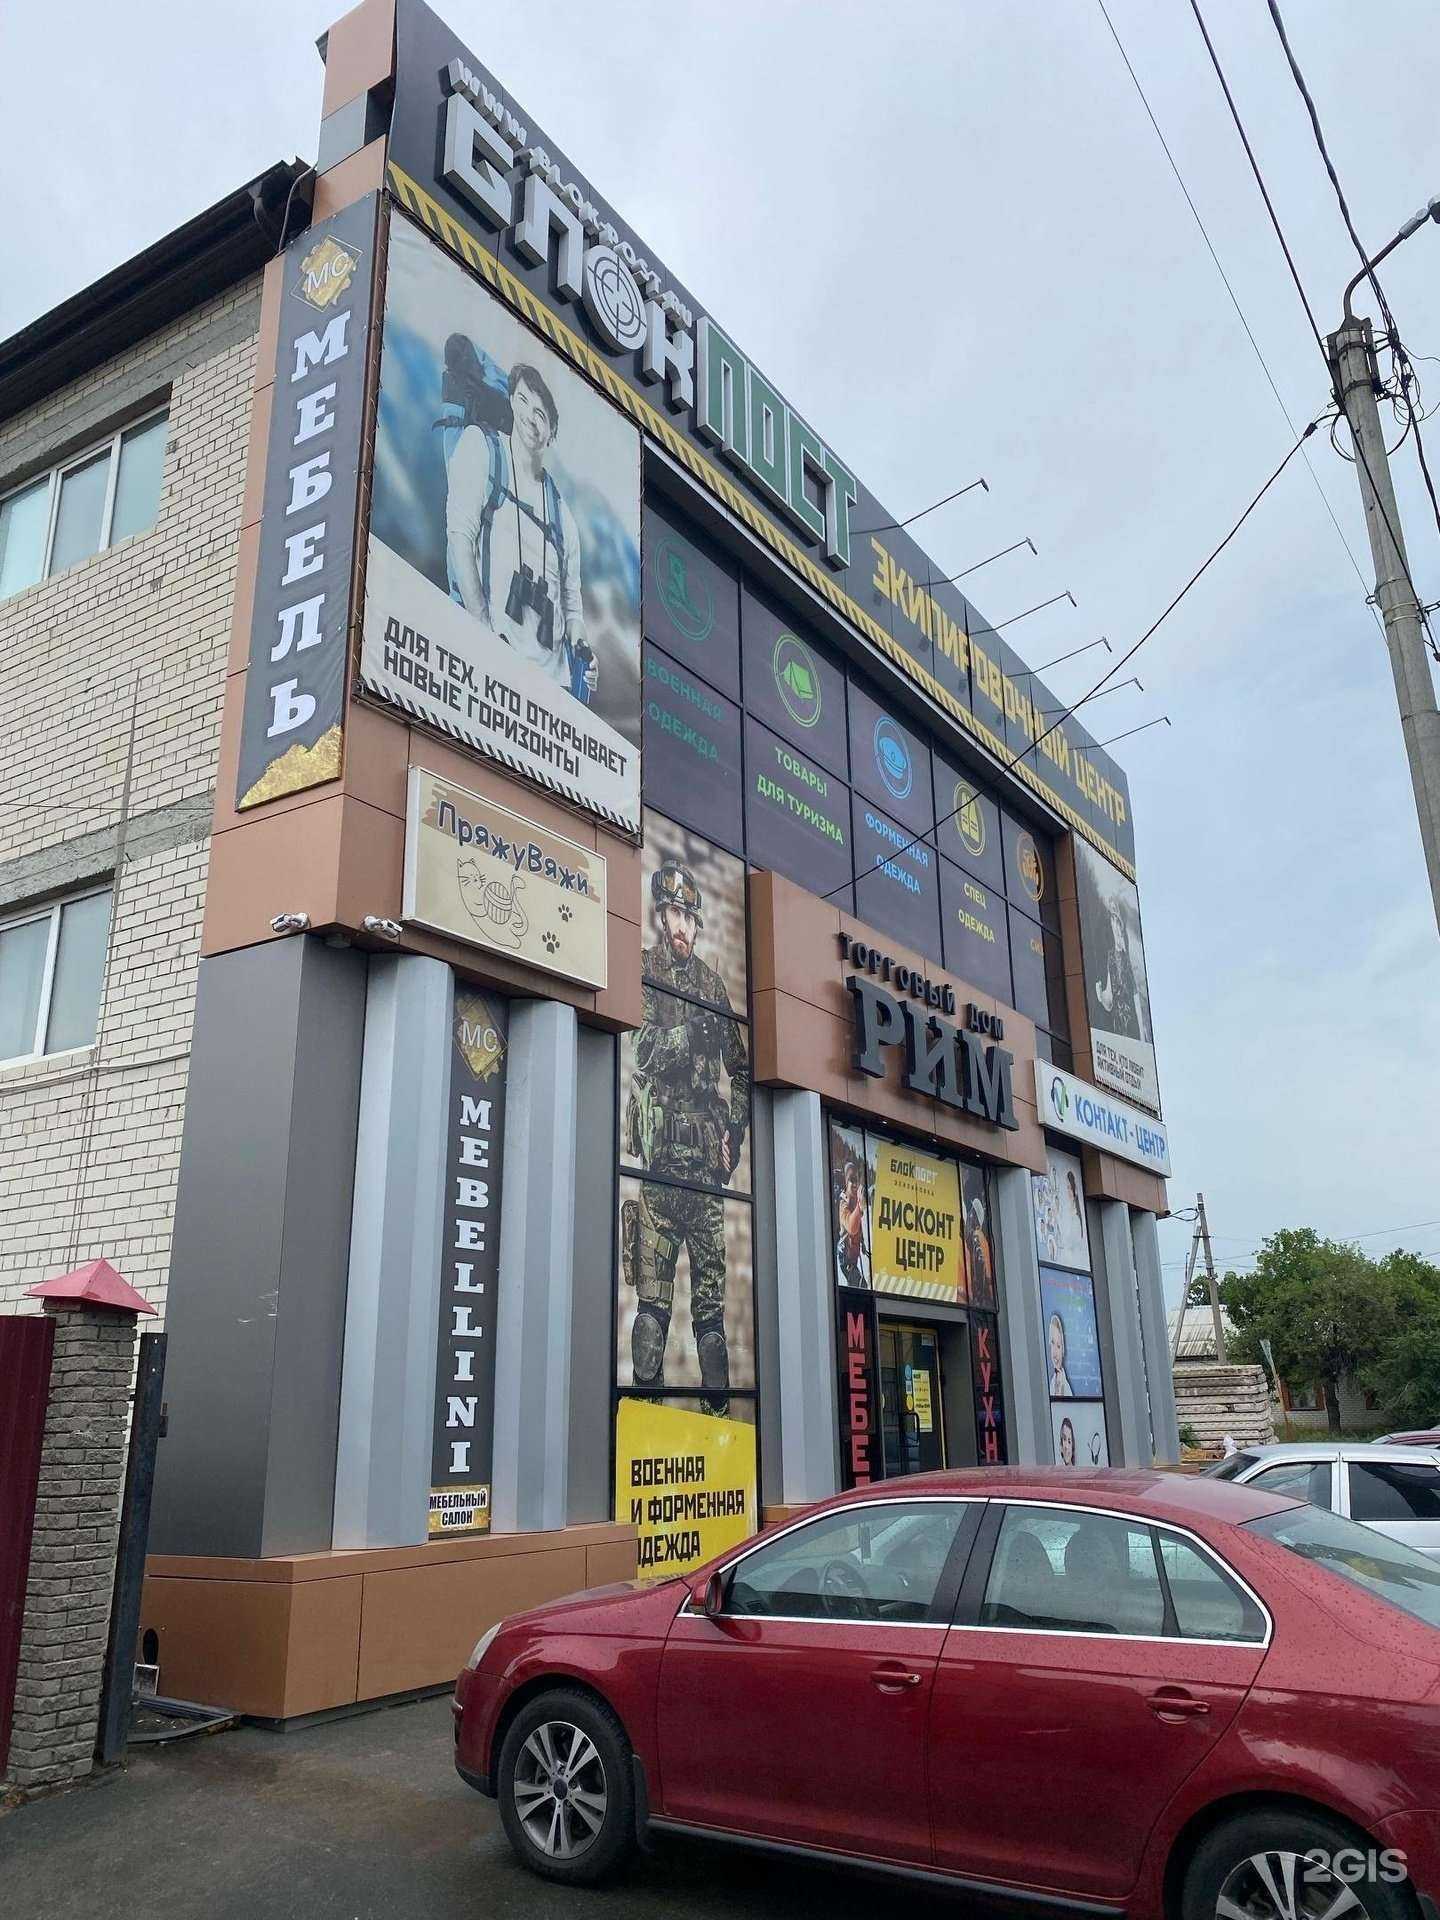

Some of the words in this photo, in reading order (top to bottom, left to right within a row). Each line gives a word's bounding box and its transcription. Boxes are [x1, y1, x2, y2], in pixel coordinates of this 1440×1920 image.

[267, 310, 352, 737] МЕБЕЛЬ
[383, 615, 429, 664] ДЛЯ
[436, 644, 479, 693] ТЕХ,
[484, 674, 521, 717] КТО
[526, 700, 628, 777] ОТКРЫВАЕТ
[383, 643, 461, 711] НОВЫЕ
[466, 695, 580, 778] ГОРИЗОНТЫ
[646, 659, 723, 721] ВОЕННАЯ
[870, 536, 1071, 778] ЭКИПИРОВОЧНЫЙ
[1072, 749, 1127, 827] ЦЕНТР
[648, 701, 718, 765] ОДЕЖДА
[775, 746, 828, 798] ТОВАРЫ
[757, 774, 785, 805] ДЛЯ
[787, 792, 844, 845] ТУРИЗМА
[865, 811, 929, 868] ФОРМЕННАЯ
[438, 799, 589, 895] ПряжуВяжи
[876, 854, 922, 895] ОДЕЖДА
[958, 908, 996, 944] ОДЕЖДА
[964, 882, 988, 910] СПЕЦ
[837, 931, 956, 1016] ТОРГОВЫЙ
[965, 1002, 1004, 1041] ДОМ
[846, 976, 1020, 1132] РИМ
[1074, 1093, 1128, 1144] КОНТАКТ
[1135, 1123, 1166, 1160] ЦЕНТР
[878, 1196, 955, 1241] ДИСКОНТ
[446, 1094, 492, 1474] MEBELLINI
[895, 1236, 945, 1273] ЦЕНТР
[847, 1311, 871, 1487] МЕБЕ
[977, 1327, 998, 1463] КУХН
[429, 1490, 487, 1510] МЕБЕЛЬНЫЙ
[631, 1455, 705, 1488] ВОЕННАЯ
[441, 1510, 473, 1526] САЛОН
[631, 1498, 643, 1526] И
[648, 1489, 745, 1525] ФОРМЕННАЯ
